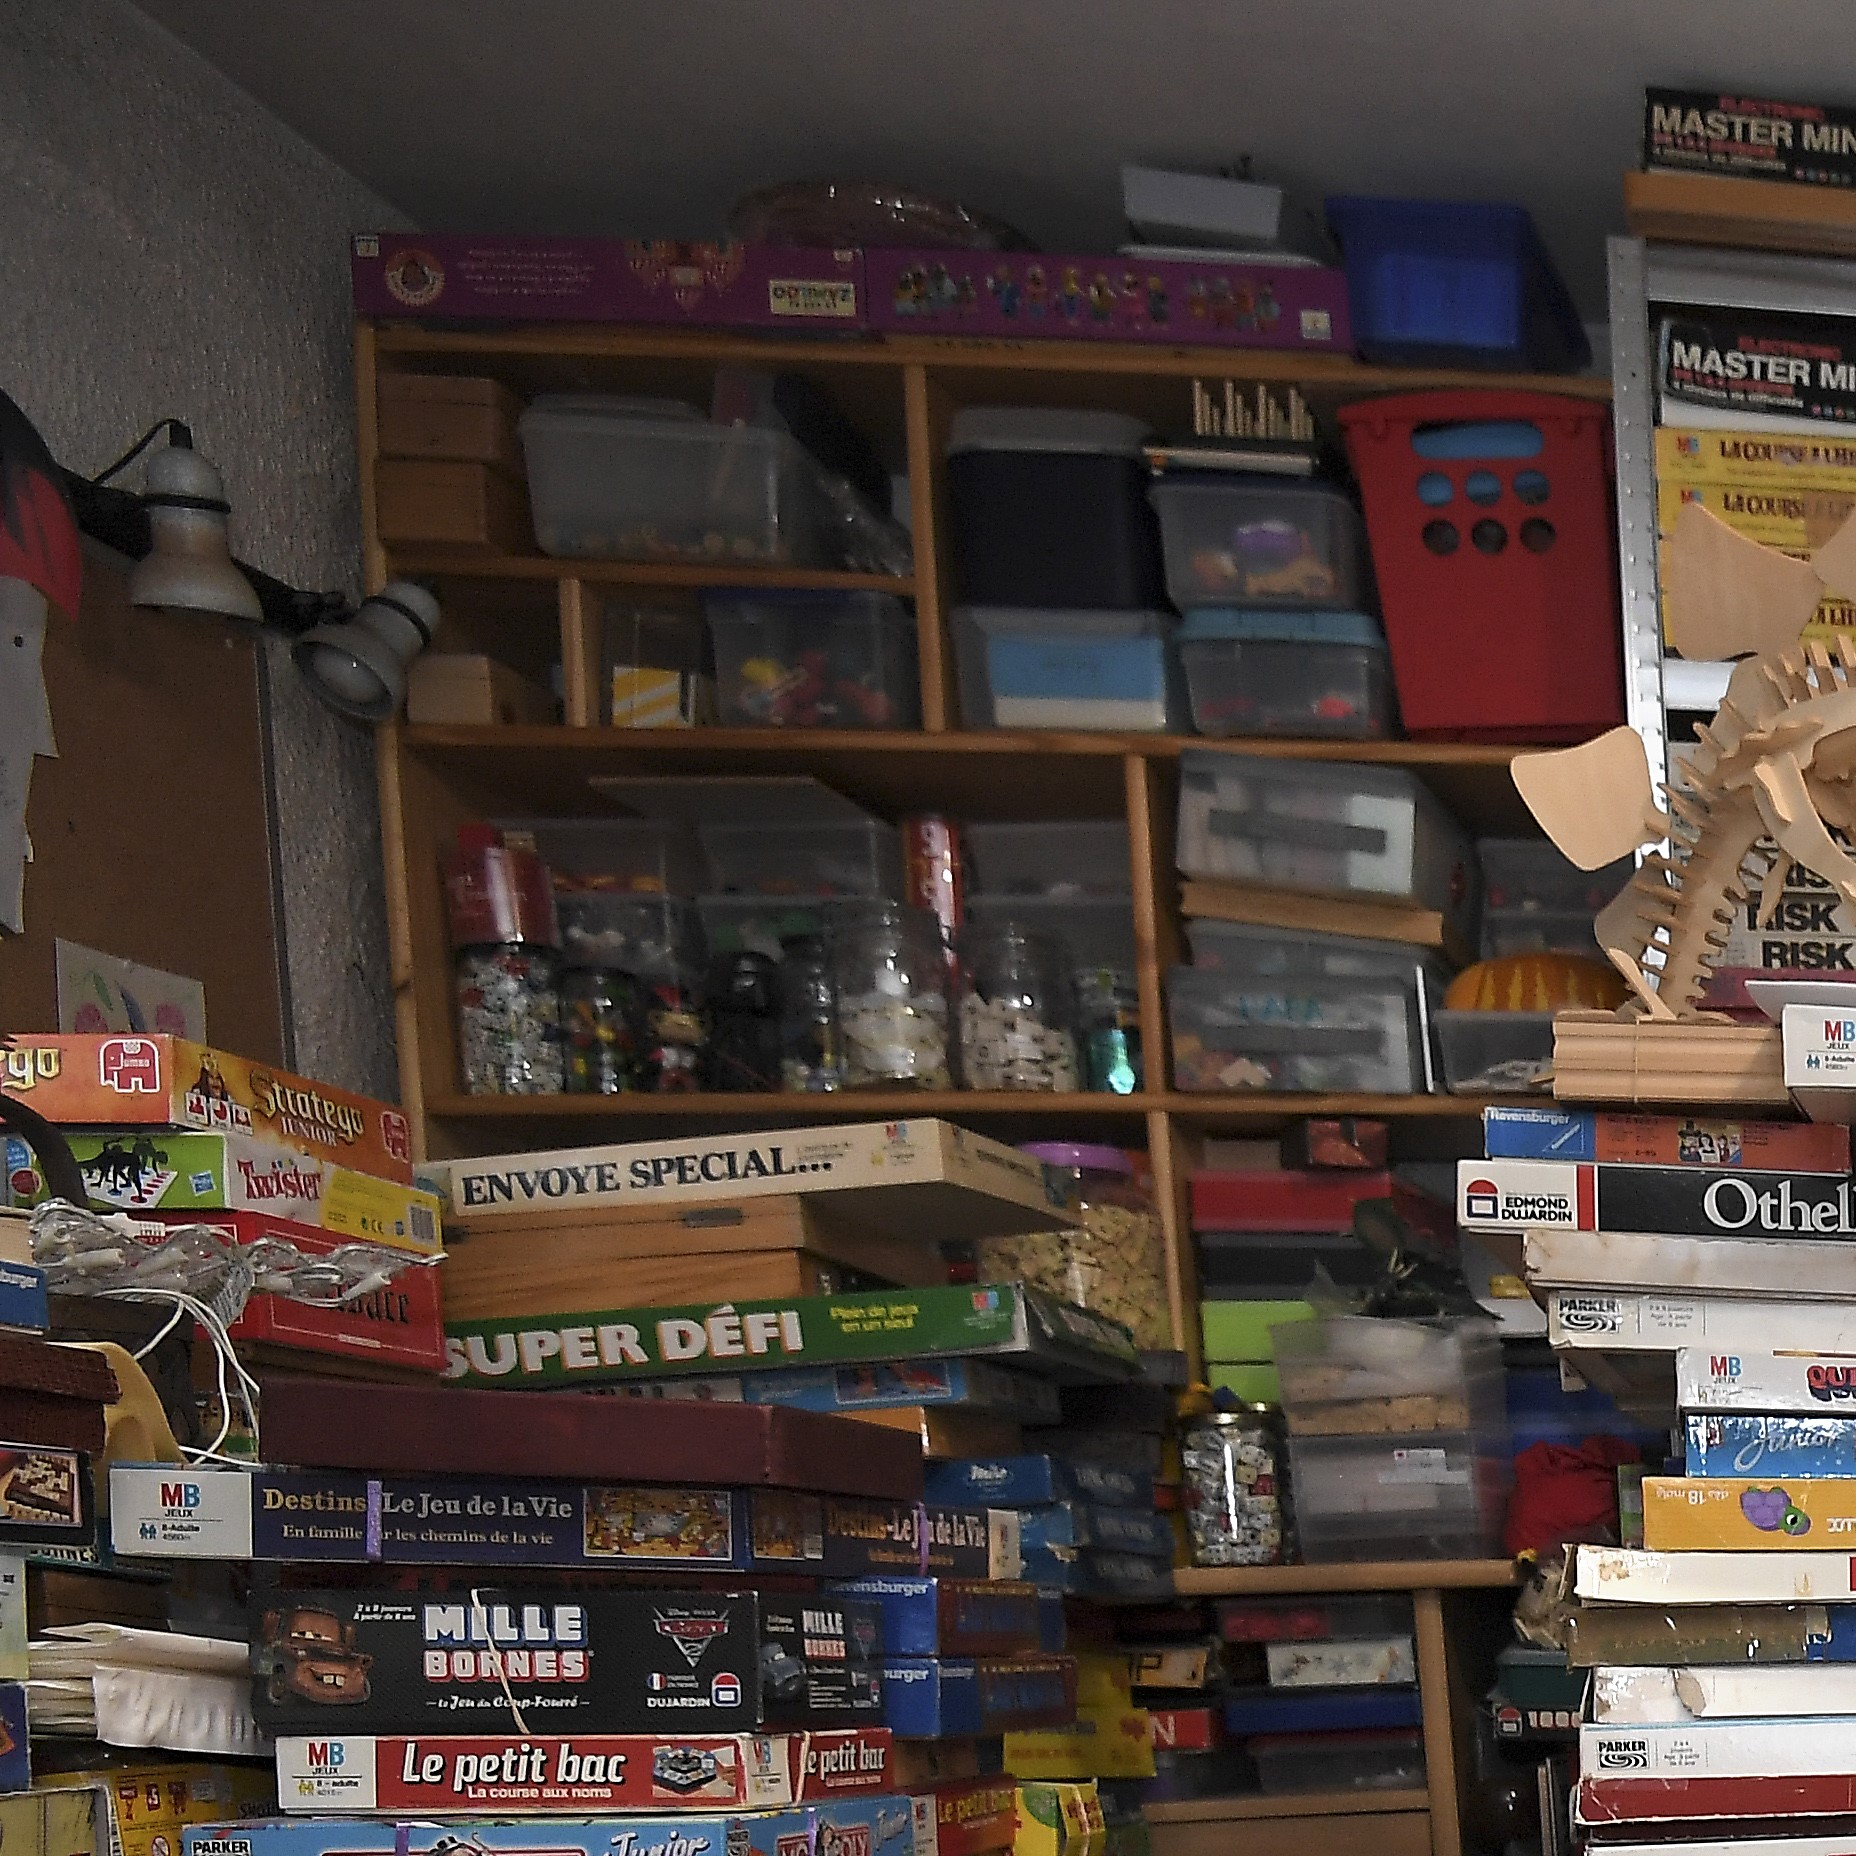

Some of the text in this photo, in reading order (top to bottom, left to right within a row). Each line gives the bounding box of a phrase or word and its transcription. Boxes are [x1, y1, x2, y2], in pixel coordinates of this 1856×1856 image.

[1651, 104, 1793, 149] MASTER
[1671, 339, 1811, 387] MASTER
[1762, 940, 1855, 970] RISK
[1823, 1020, 1856, 1041] MB
[250, 1069, 366, 1146] Stratego
[281, 1117, 340, 1148] JUNIOR
[236, 1158, 321, 1202] Twister
[460, 1161, 622, 1207] ENVOYE
[1501, 1209, 1573, 1223] DUJARDIN
[1505, 1197, 1569, 1210] EDMOND
[441, 1323, 650, 1379] SUPER
[656, 1302, 802, 1362] DÉFI
[1710, 1355, 1742, 1377] MB
[160, 1482, 201, 1508] MB
[263, 1487, 574, 1519] Destins Le Jeu de la Vie
[164, 1509, 194, 1518] JEUX
[306, 1524, 529, 1545] famille chemins de la
[423, 1604, 588, 1648] MILLE
[423, 1650, 590, 1684] BORNES
[307, 1742, 345, 1767] MB
[820, 1739, 886, 1781] petit bac
[1598, 1740, 1647, 1752] PARKER
[402, 1741, 629, 1792] Le petit bac
[192, 1839, 250, 1856] PARKER
